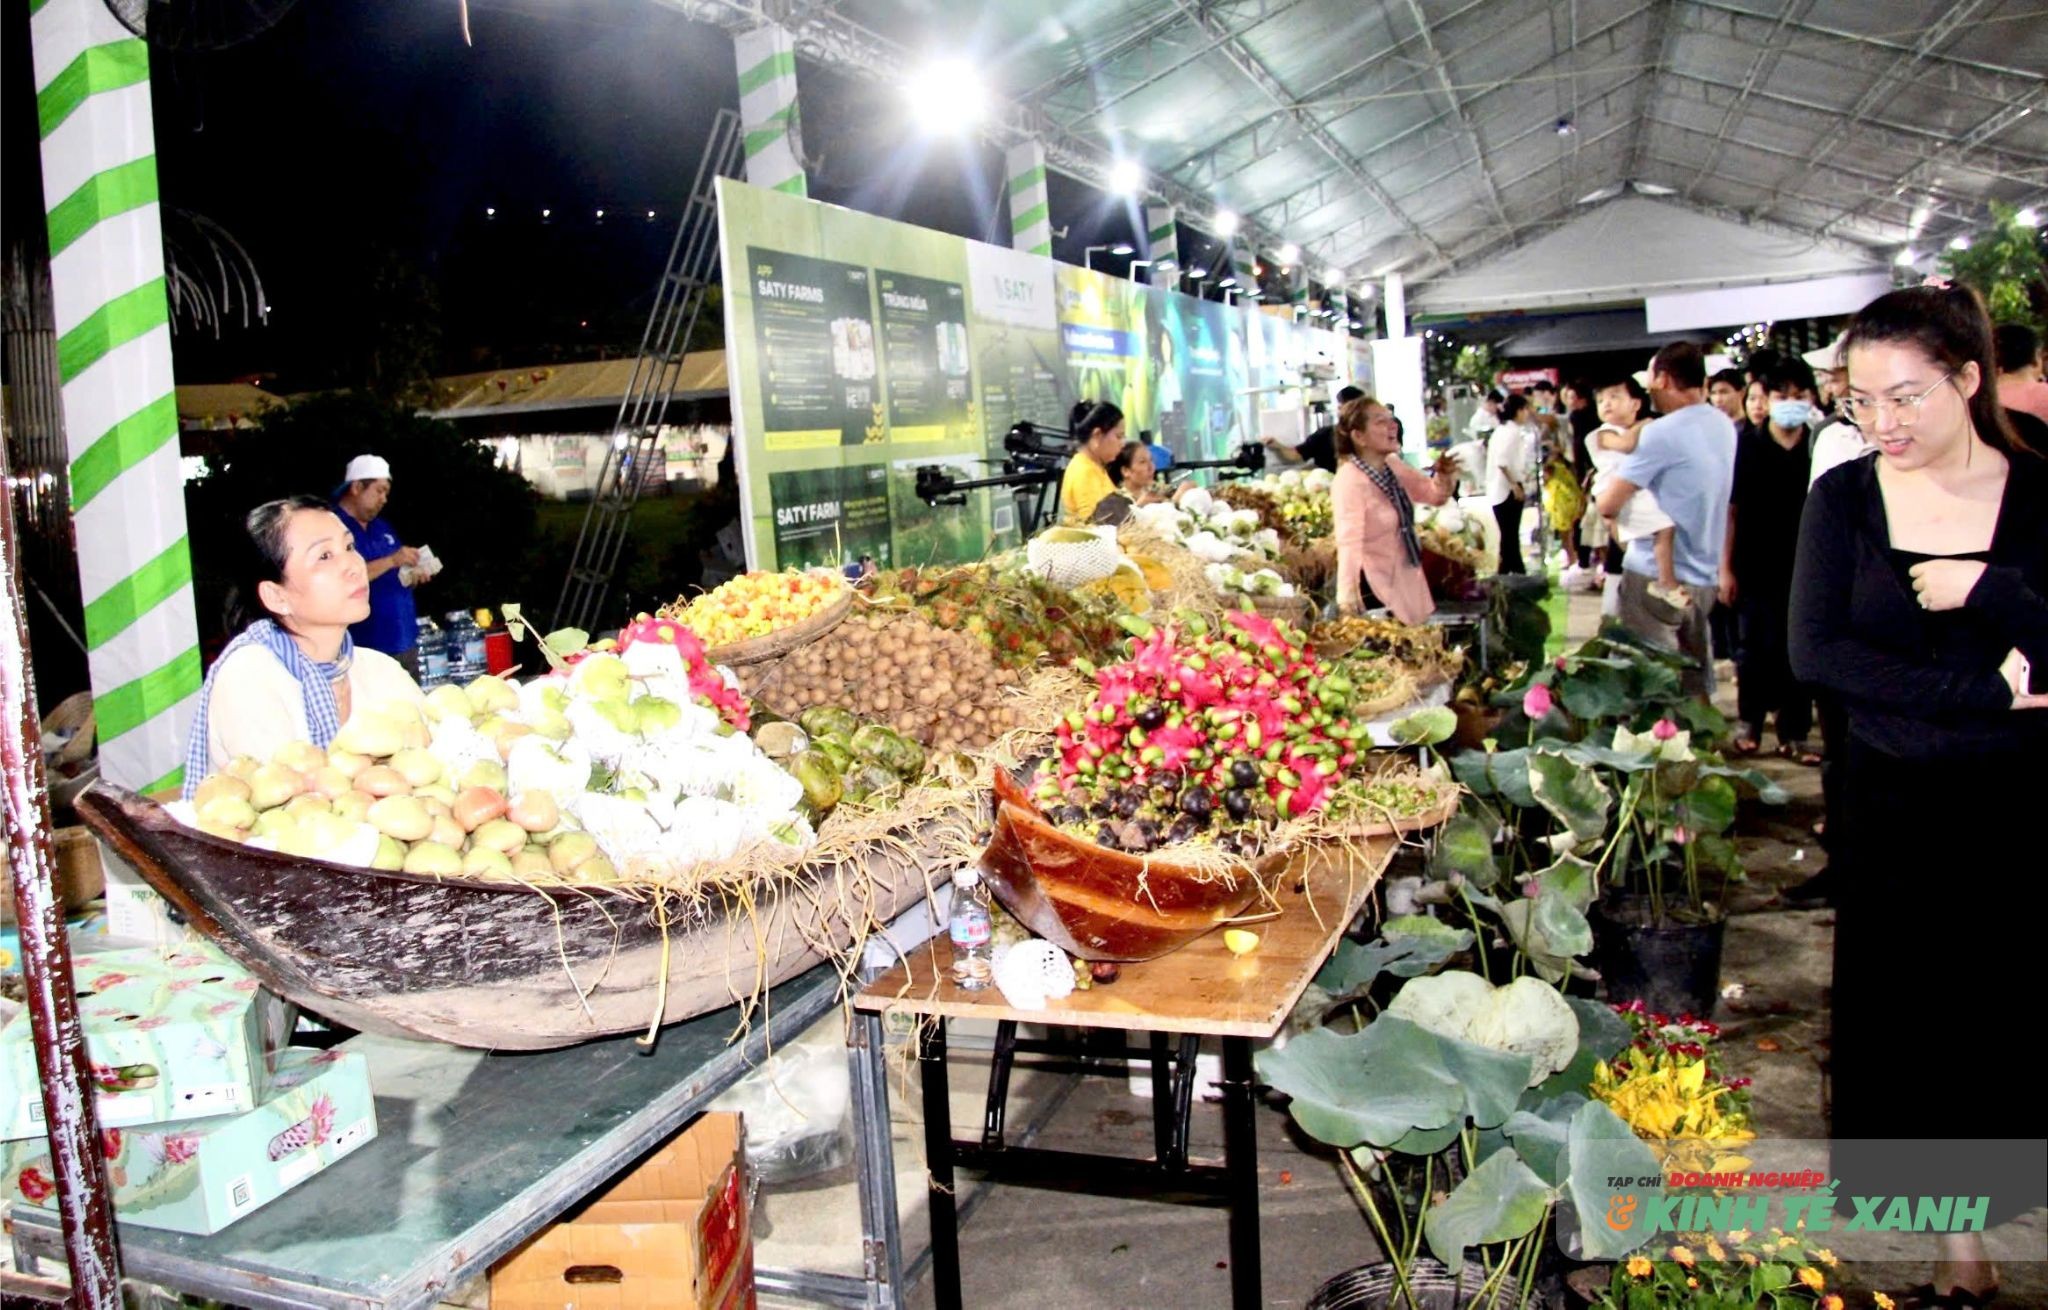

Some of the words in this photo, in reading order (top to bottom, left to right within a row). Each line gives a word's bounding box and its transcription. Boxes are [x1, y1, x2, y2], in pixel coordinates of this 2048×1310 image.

[758, 280, 787, 298] SATY
[788, 284, 824, 303] FARMS
[1004, 278, 1033, 302] SATY
[777, 505, 808, 526] SATY
[809, 501, 840, 521] FARM
